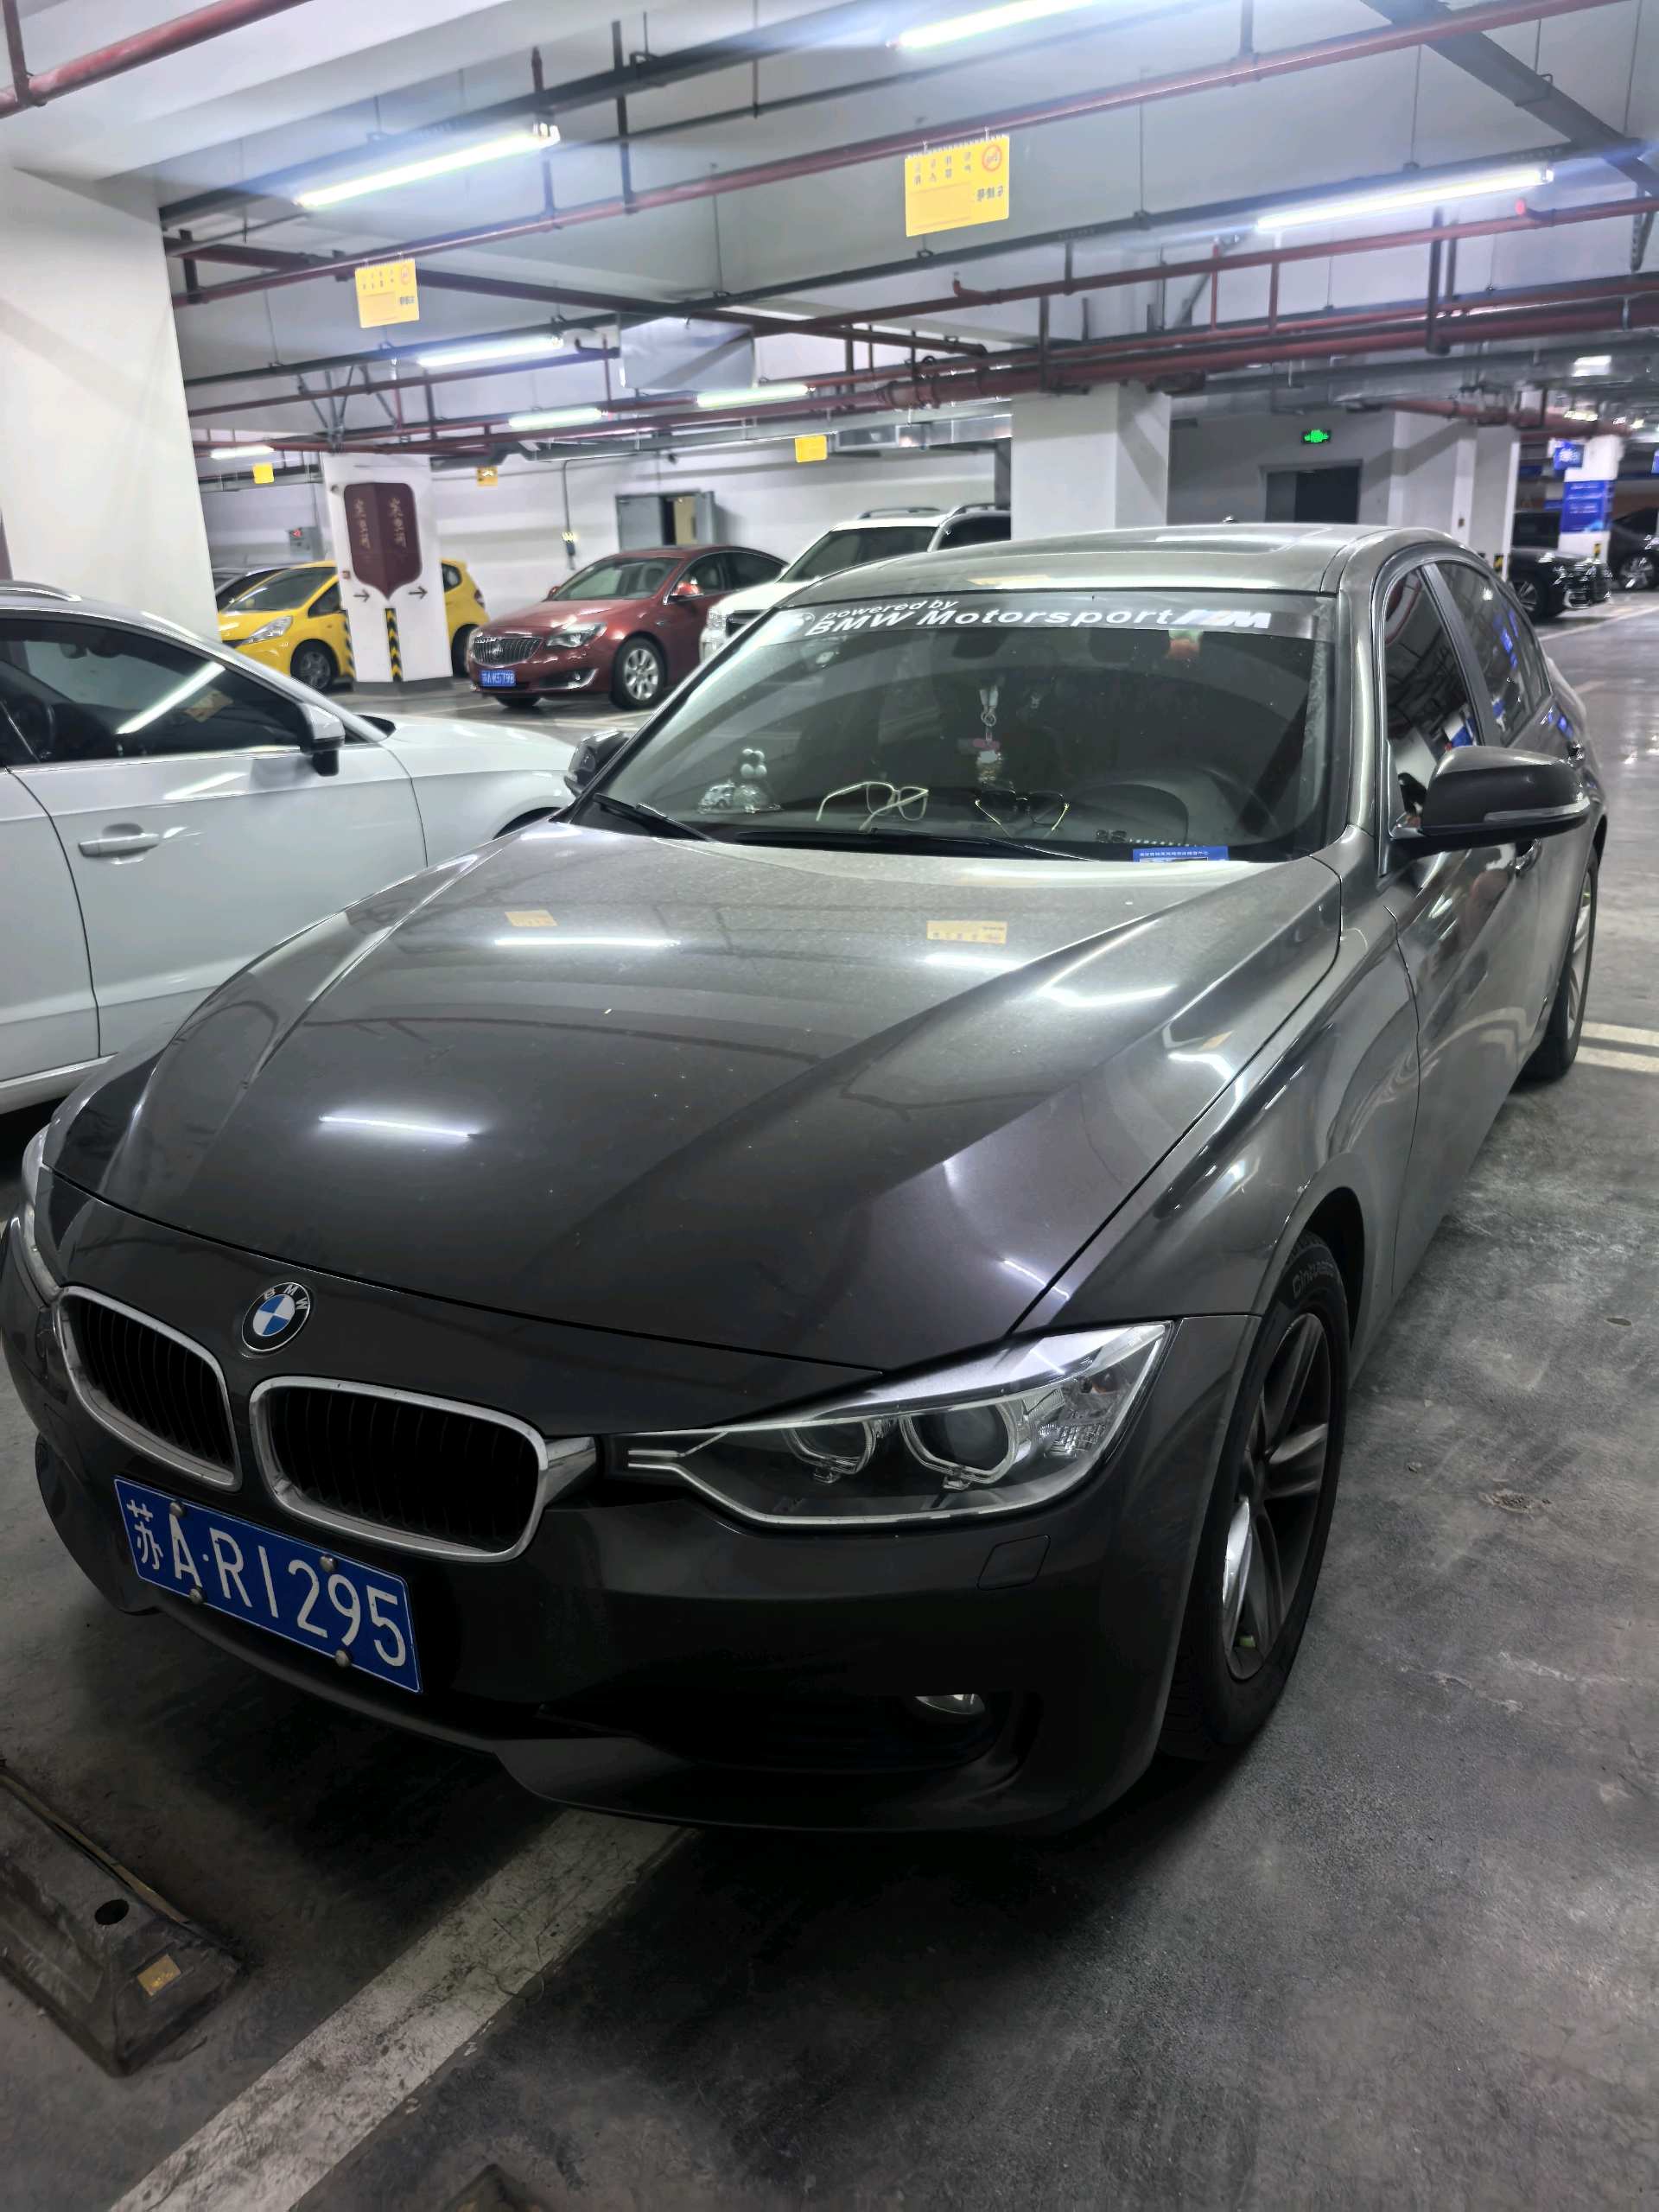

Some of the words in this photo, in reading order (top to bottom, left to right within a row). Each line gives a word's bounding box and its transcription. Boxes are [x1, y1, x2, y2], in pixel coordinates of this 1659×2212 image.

[804, 611, 916, 637] BMW
[917, 608, 1173, 627] Motorsport
[821, 601, 928, 620] powered
[928, 600, 959, 610] by
[264, 1284, 309, 1311] BMW
[126, 1500, 406, 1667] 苏A·R1295
